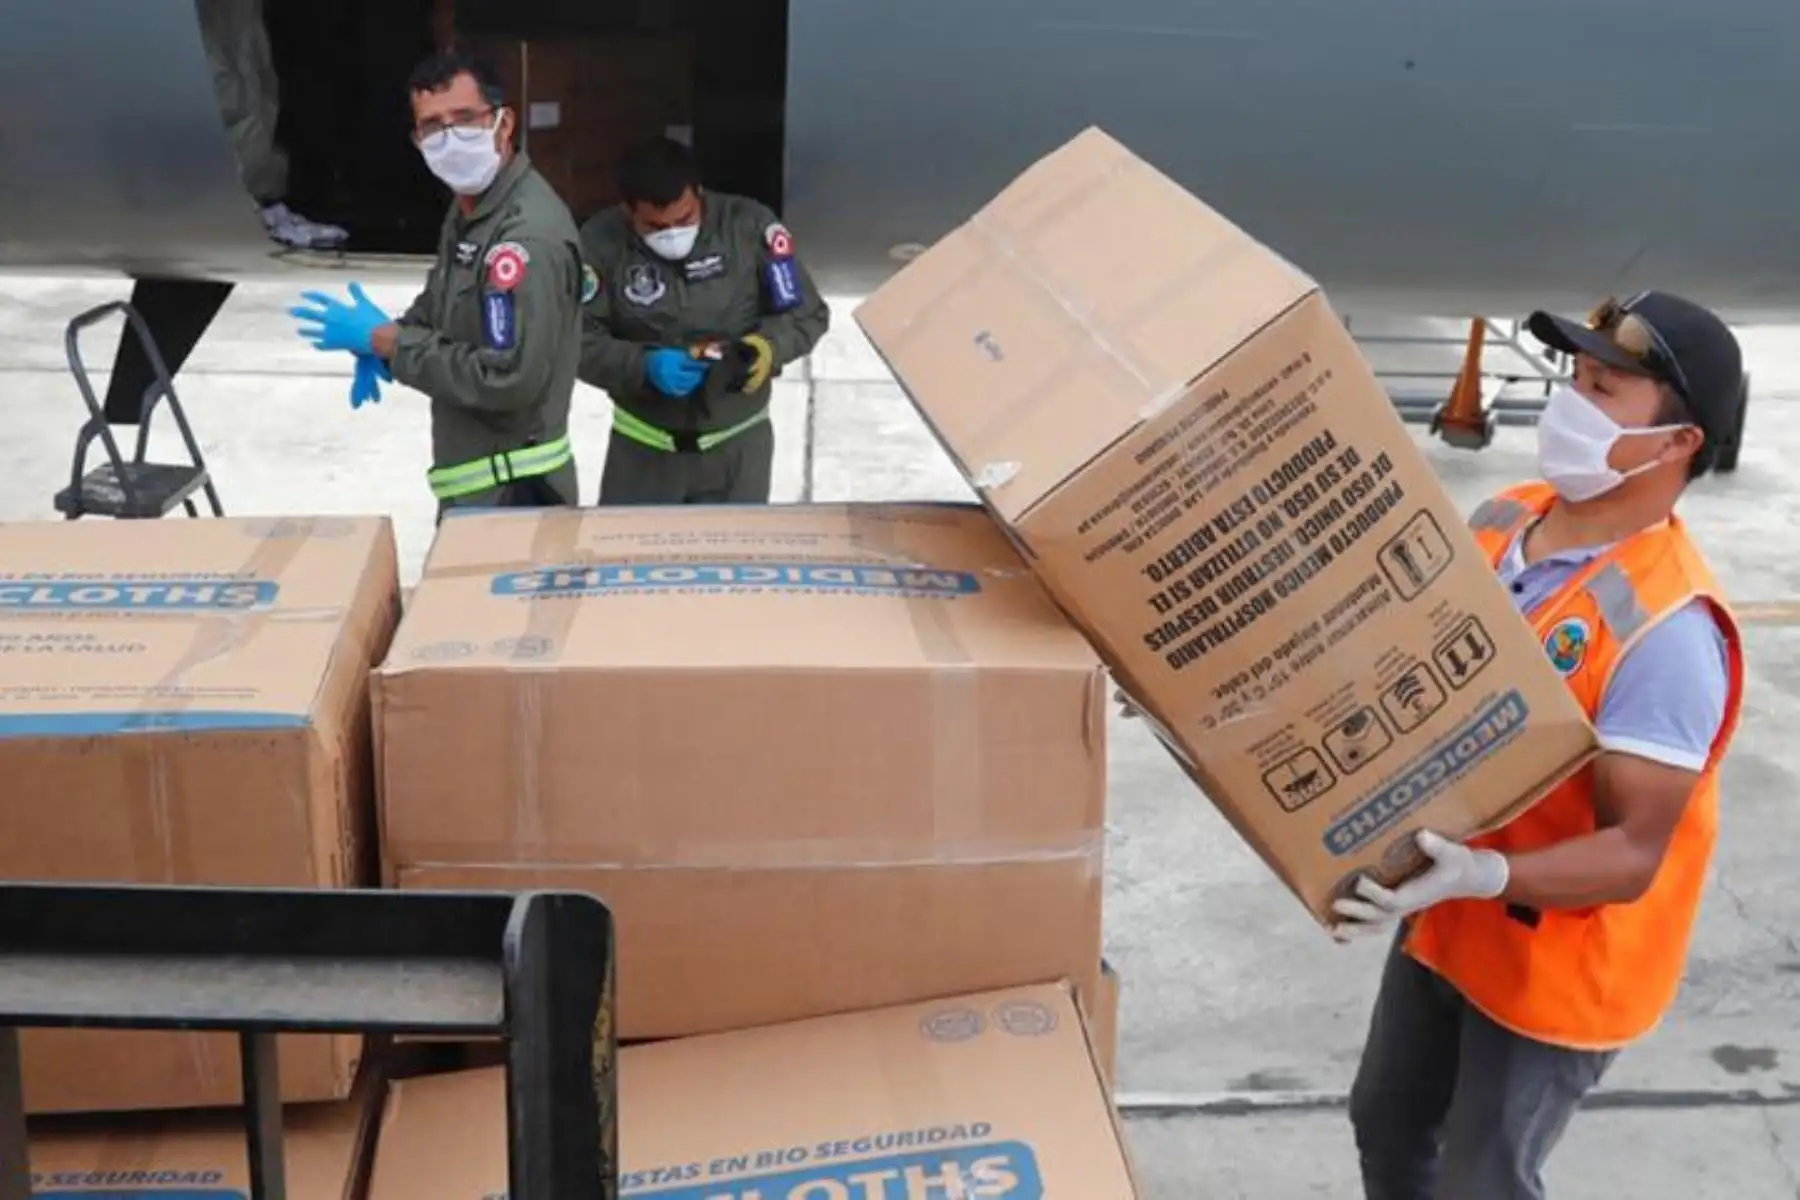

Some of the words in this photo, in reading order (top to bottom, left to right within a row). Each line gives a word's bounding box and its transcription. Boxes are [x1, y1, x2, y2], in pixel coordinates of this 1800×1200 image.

[1249, 428, 1337, 507] PRODUCTO
[1314, 462, 1343, 494] SU
[1336, 445, 1362, 476] DE
[1369, 451, 1394, 482] DE
[1339, 470, 1376, 508] USO
[1210, 493, 1257, 536] ESTA
[1254, 510, 1285, 541] NO
[1327, 479, 1405, 555] PRODUCTO
[1139, 523, 1218, 586] ABIERTO.
[1184, 527, 1261, 591] UTILIZAR
[1213, 538, 1296, 606] DESTRUIR
[1271, 543, 1335, 599] MEDICO
[510, 564, 958, 592] MEDICLOTHS
[1167, 578, 1193, 604] SI
[1141, 594, 1220, 653] DESPUES
[1148, 590, 1174, 616] EL
[1164, 587, 1277, 672] HOSPITALARIO
[1248, 653, 1276, 679] del
[1329, 698, 1522, 849] MEDICLOTHS
[708, 1154, 749, 1176] EN
[756, 1146, 809, 1169] BIO
[812, 1121, 994, 1161] SEGURIDAD
[46, 1171, 223, 1185] SEGURIDAD
